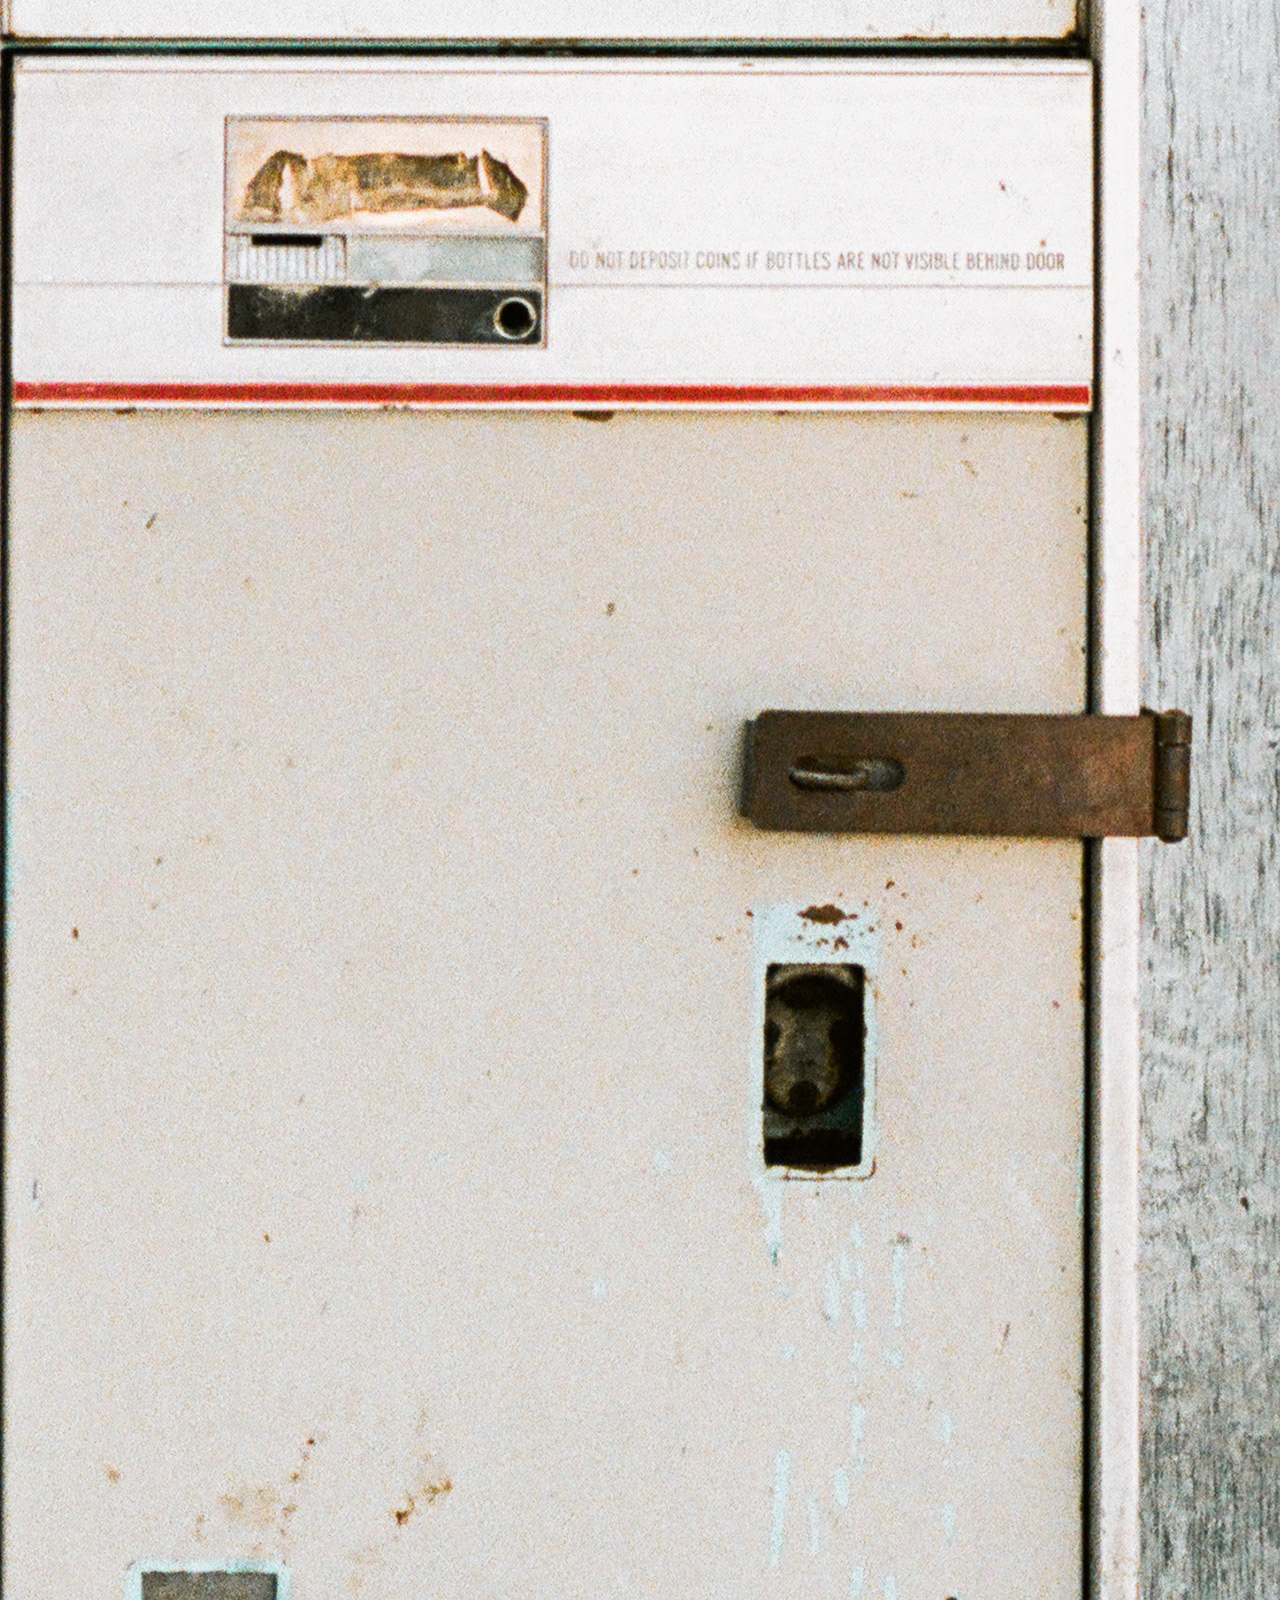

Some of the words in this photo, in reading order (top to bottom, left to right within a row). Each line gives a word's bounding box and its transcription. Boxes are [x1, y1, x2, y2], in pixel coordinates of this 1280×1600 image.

[569, 250, 589, 270] DO
[595, 250, 623, 270] NOT
[629, 250, 690, 270] DEPOSIT
[696, 250, 741, 270] COINS
[746, 250, 760, 270] IF
[765, 250, 831, 270] BOTTLES
[837, 250, 865, 270] ARE
[871, 250, 900, 270] NOT
[905, 250, 960, 270] VISIBLE
[965, 250, 1020, 270] BEHIND
[1026, 250, 1065, 270] DOOR
